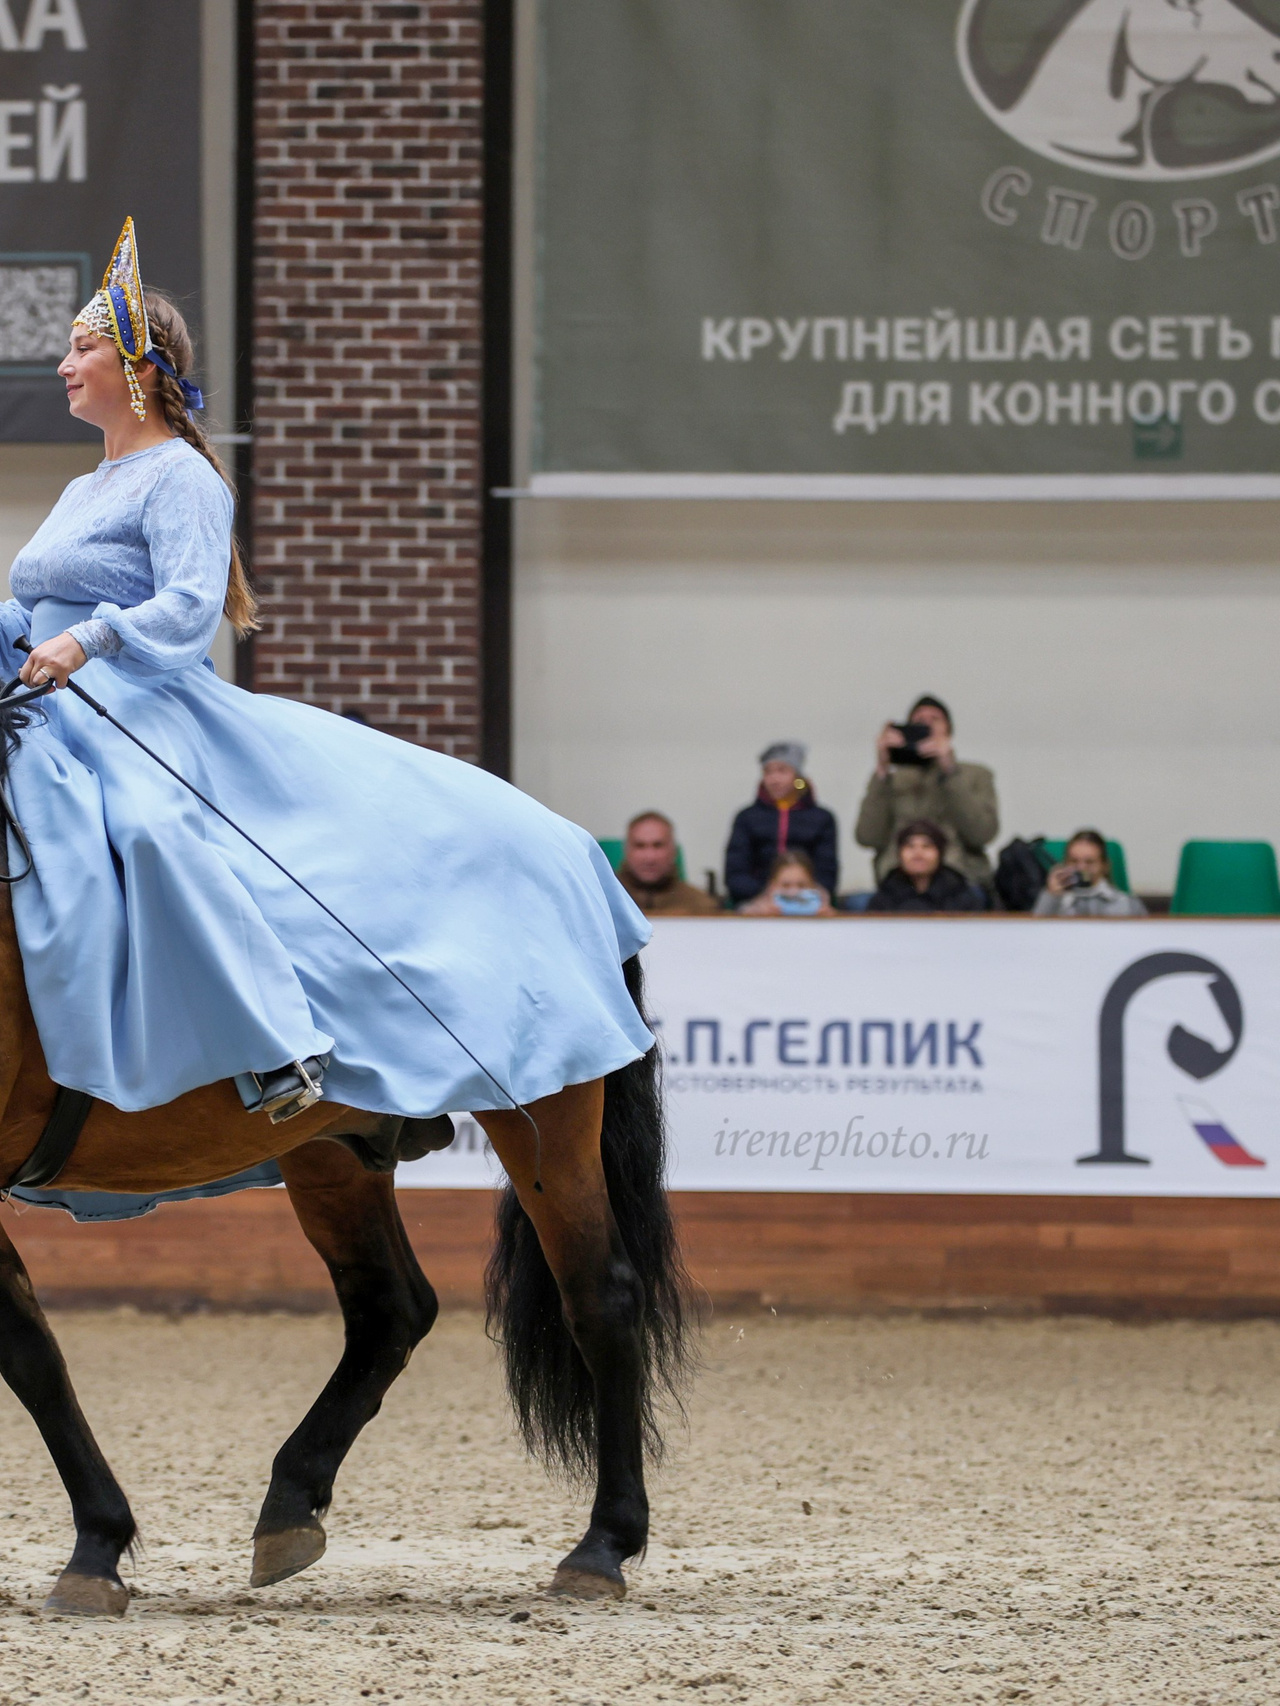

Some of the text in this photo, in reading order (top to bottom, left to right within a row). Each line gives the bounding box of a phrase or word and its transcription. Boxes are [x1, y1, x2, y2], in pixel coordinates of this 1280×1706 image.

[701, 308, 1091, 362] КРУПНЕЙШАЯ
[1108, 315, 1254, 362] СЕТЬ
[833, 381, 952, 434] ДЛЯ
[968, 380, 1237, 426] КОННОГО
[651, 1017, 985, 1068] .П.ГЕЛПИК
